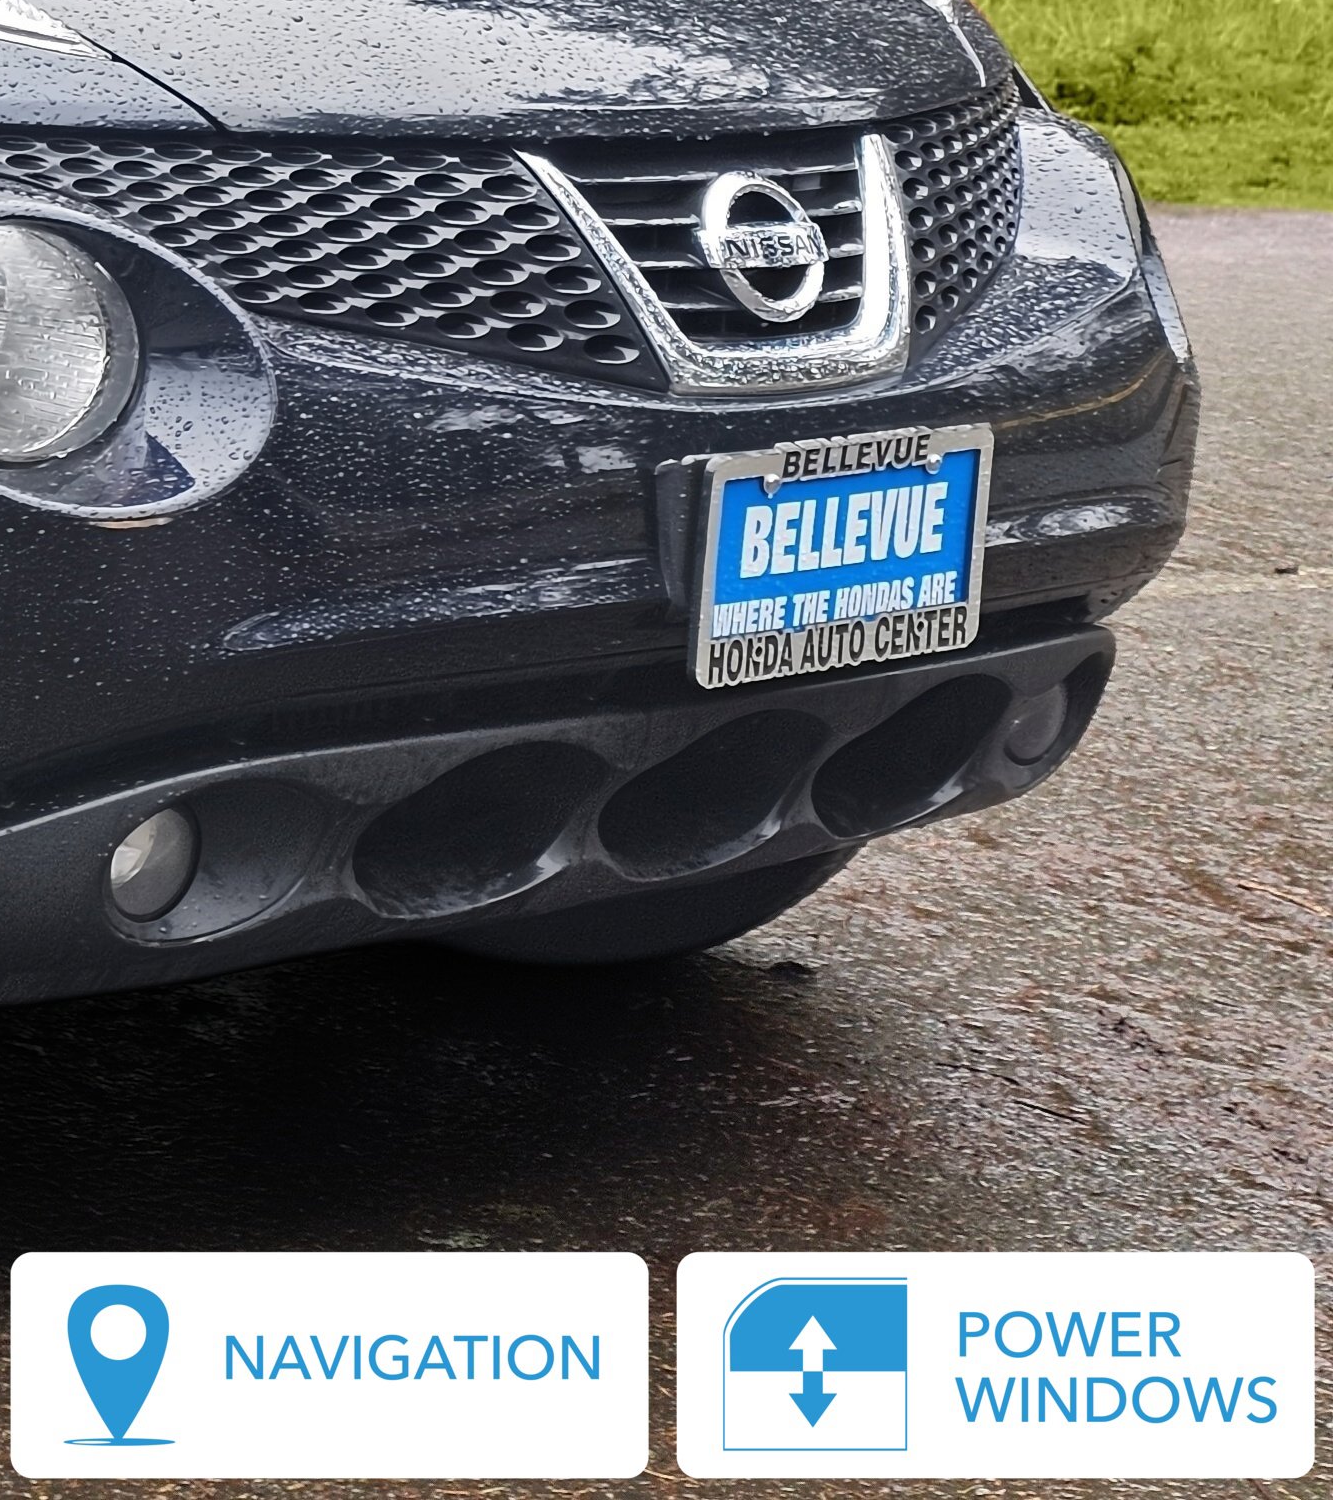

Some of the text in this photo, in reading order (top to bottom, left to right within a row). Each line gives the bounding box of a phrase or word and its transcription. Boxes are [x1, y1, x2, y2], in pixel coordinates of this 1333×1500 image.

[724, 234, 824, 260] NISSAN
[783, 433, 931, 479] BELLEVUE
[739, 481, 948, 579] BELLEVUE
[712, 570, 958, 638] WHERE THE HONDAS ARE
[708, 606, 968, 685] HONDA AUTO CENTER
